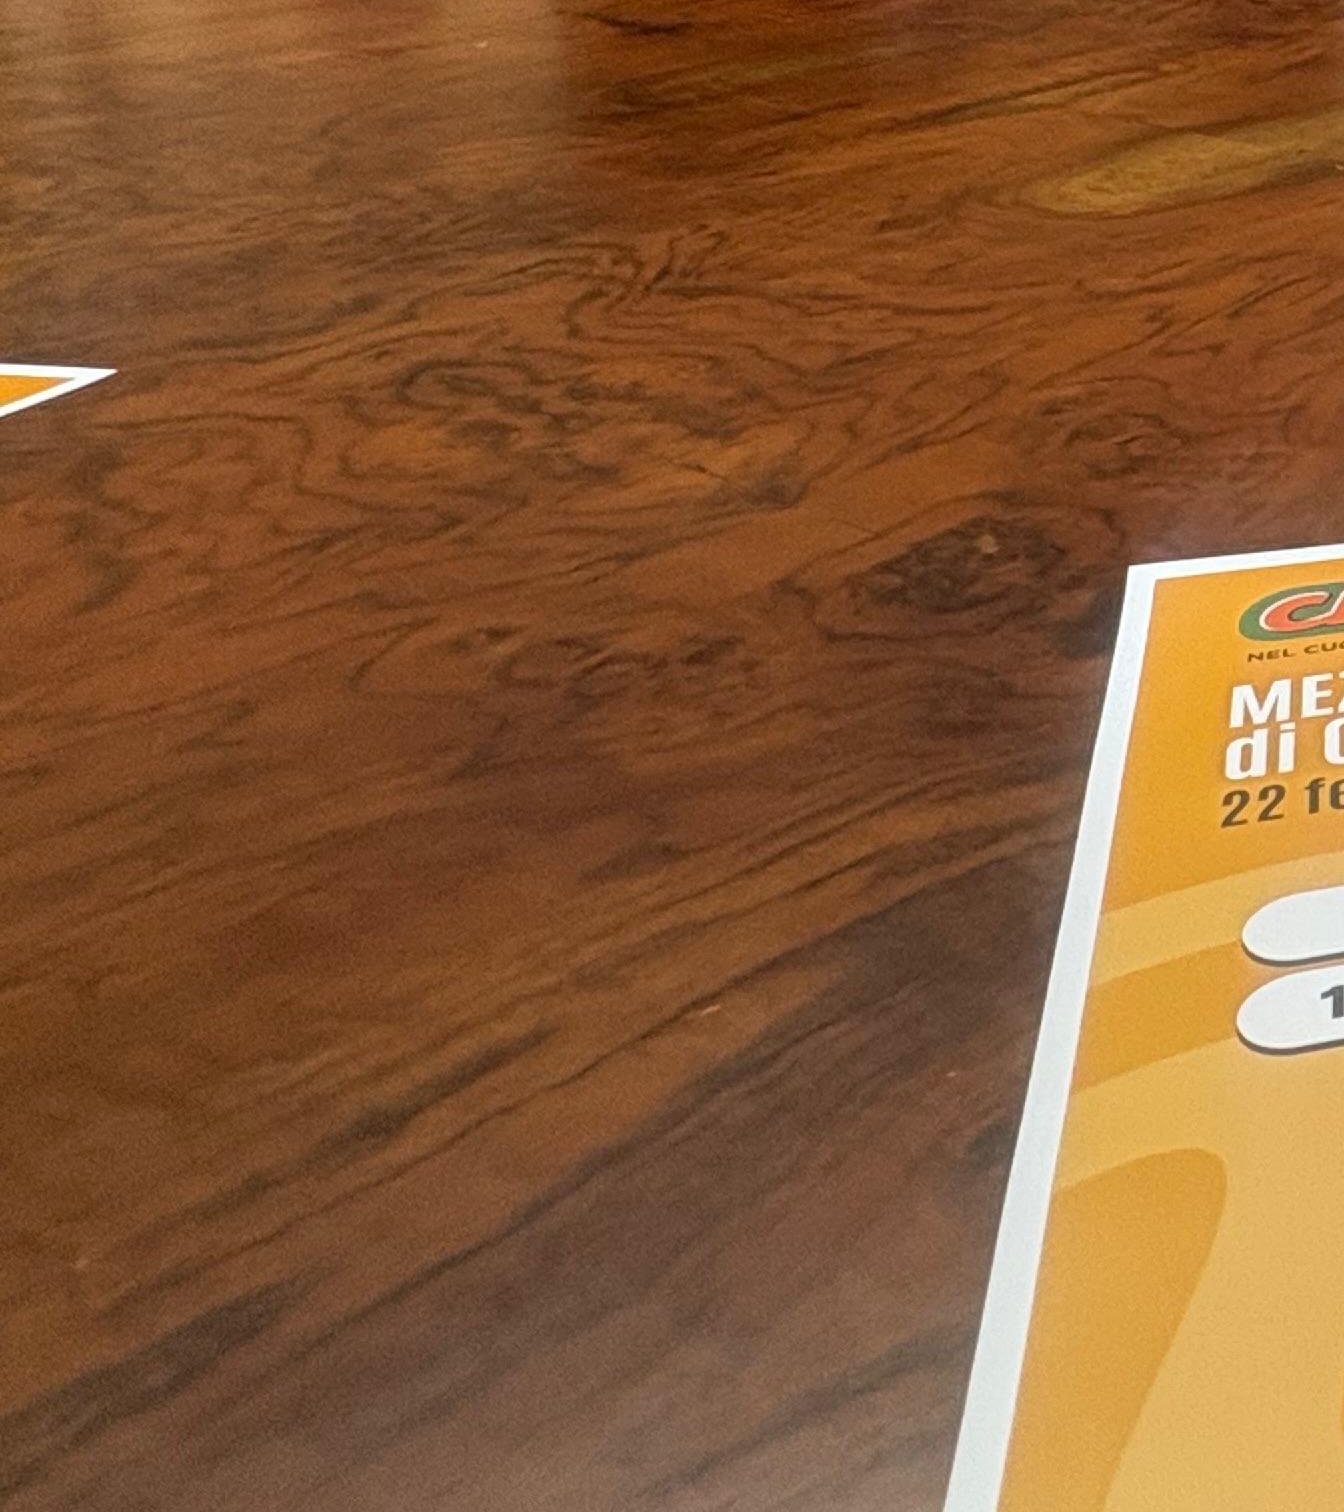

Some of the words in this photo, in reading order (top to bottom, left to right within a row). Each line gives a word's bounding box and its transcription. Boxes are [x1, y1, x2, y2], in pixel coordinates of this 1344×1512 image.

[1247, 648, 1296, 663] NEL
[1223, 722, 1297, 781] di
[1219, 784, 1286, 828] 22
